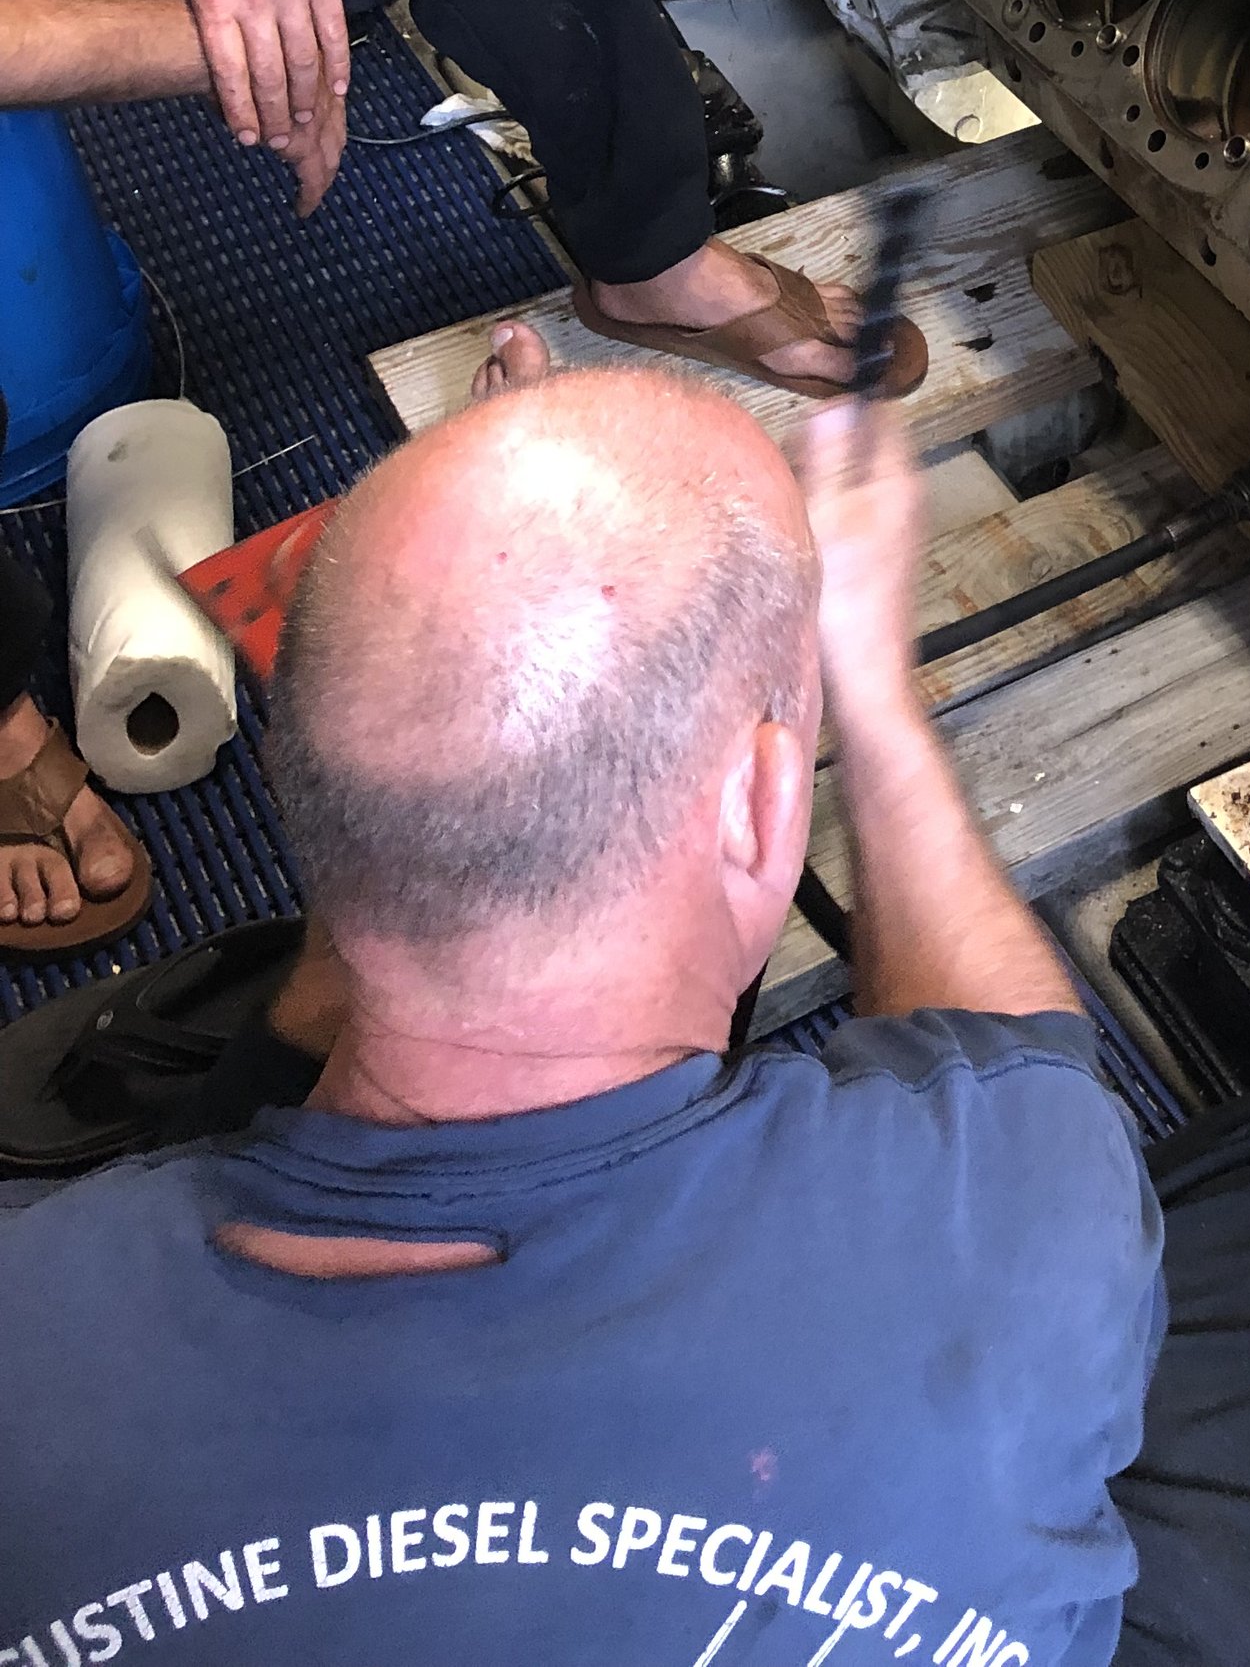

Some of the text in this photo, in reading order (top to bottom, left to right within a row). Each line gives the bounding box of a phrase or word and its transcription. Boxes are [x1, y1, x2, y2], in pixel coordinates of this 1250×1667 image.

[0, 1537, 289, 1667] USTINE
[309, 1500, 549, 1588] DIESEL
[570, 1502, 938, 1658] SPECIALIST,
